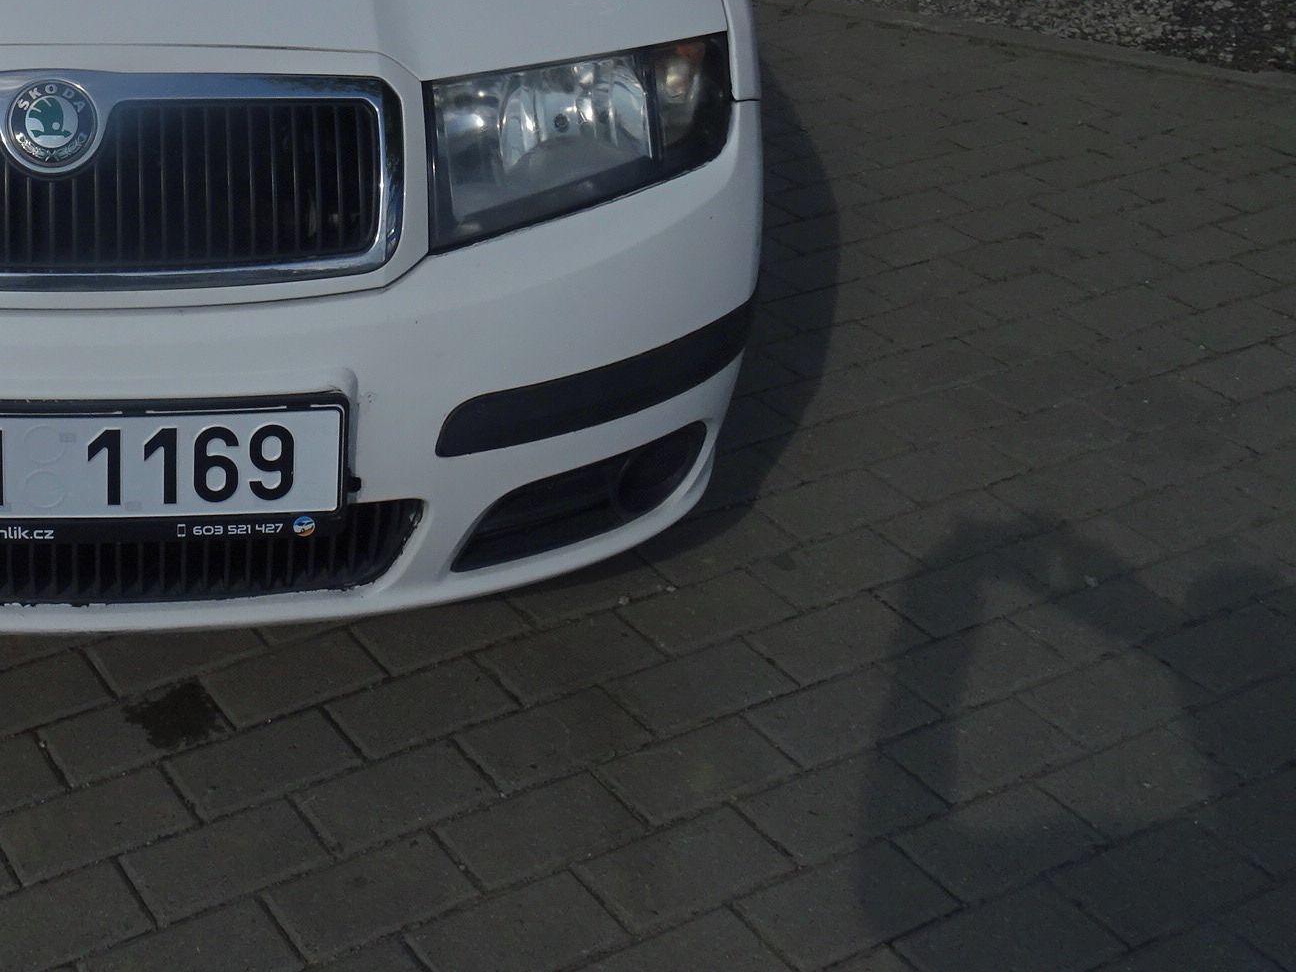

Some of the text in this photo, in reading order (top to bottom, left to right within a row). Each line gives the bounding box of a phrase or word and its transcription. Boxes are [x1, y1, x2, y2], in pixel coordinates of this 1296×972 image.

[87, 424, 295, 506] 1169
[192, 523, 284, 536] 603 521 427
